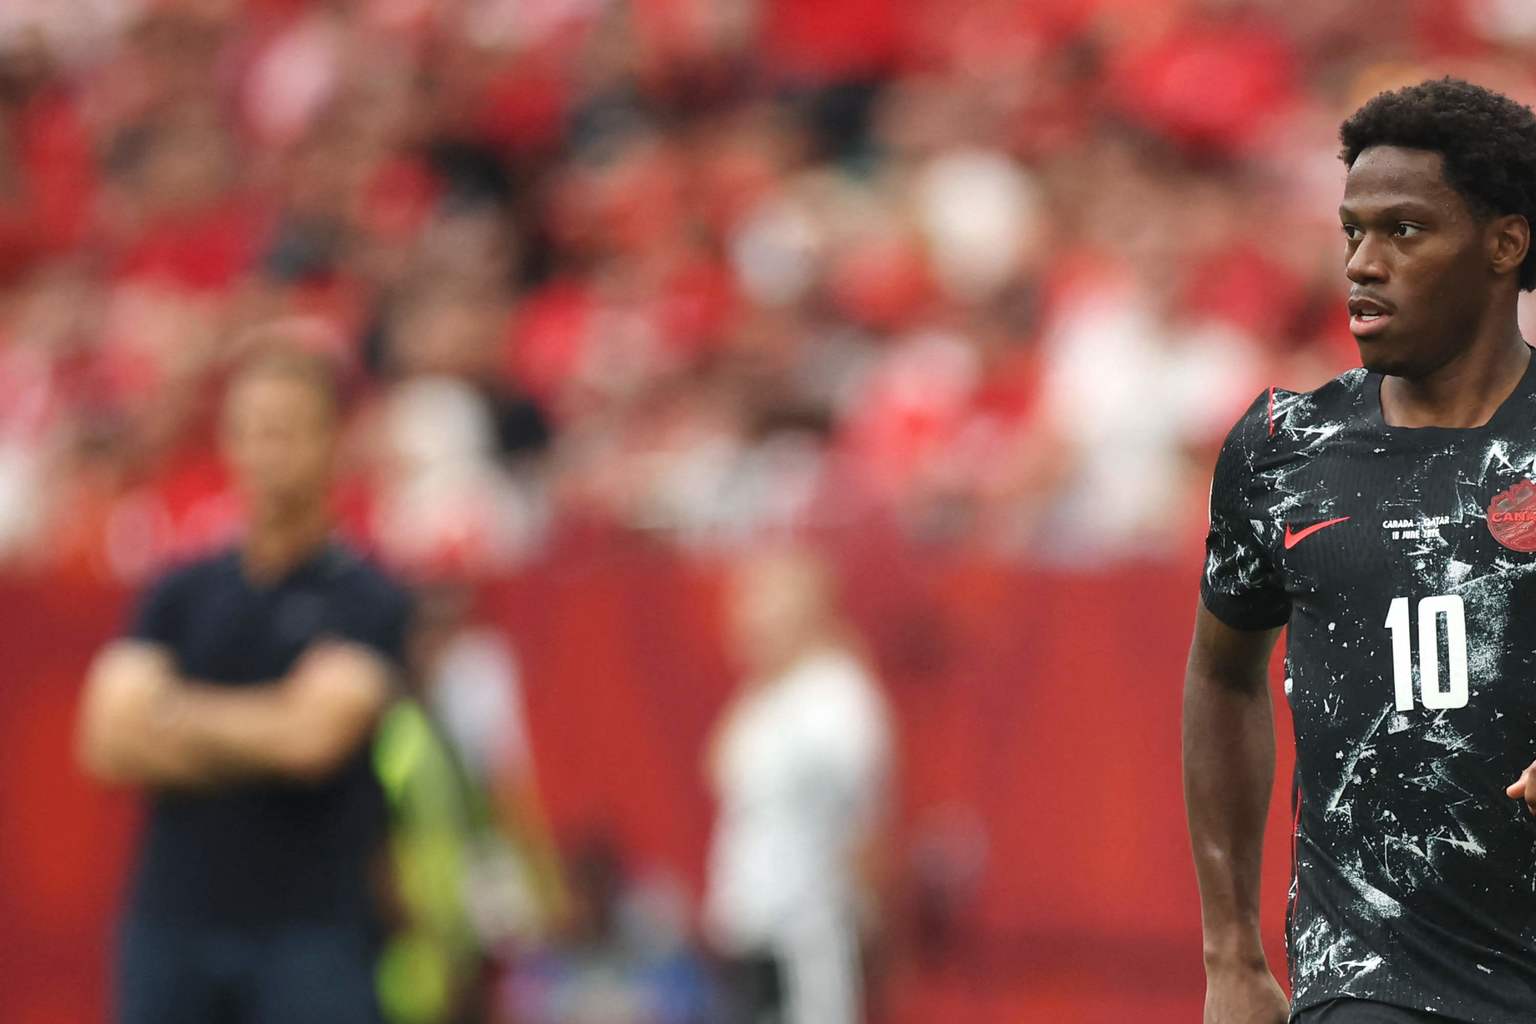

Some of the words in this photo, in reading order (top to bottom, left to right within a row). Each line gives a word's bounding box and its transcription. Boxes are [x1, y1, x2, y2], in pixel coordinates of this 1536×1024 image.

[1382, 519, 1414, 529] CANADA
[1423, 515, 1450, 528] QATAR
[1401, 529, 1420, 540] JUNE
[1384, 594, 1469, 712] 10
